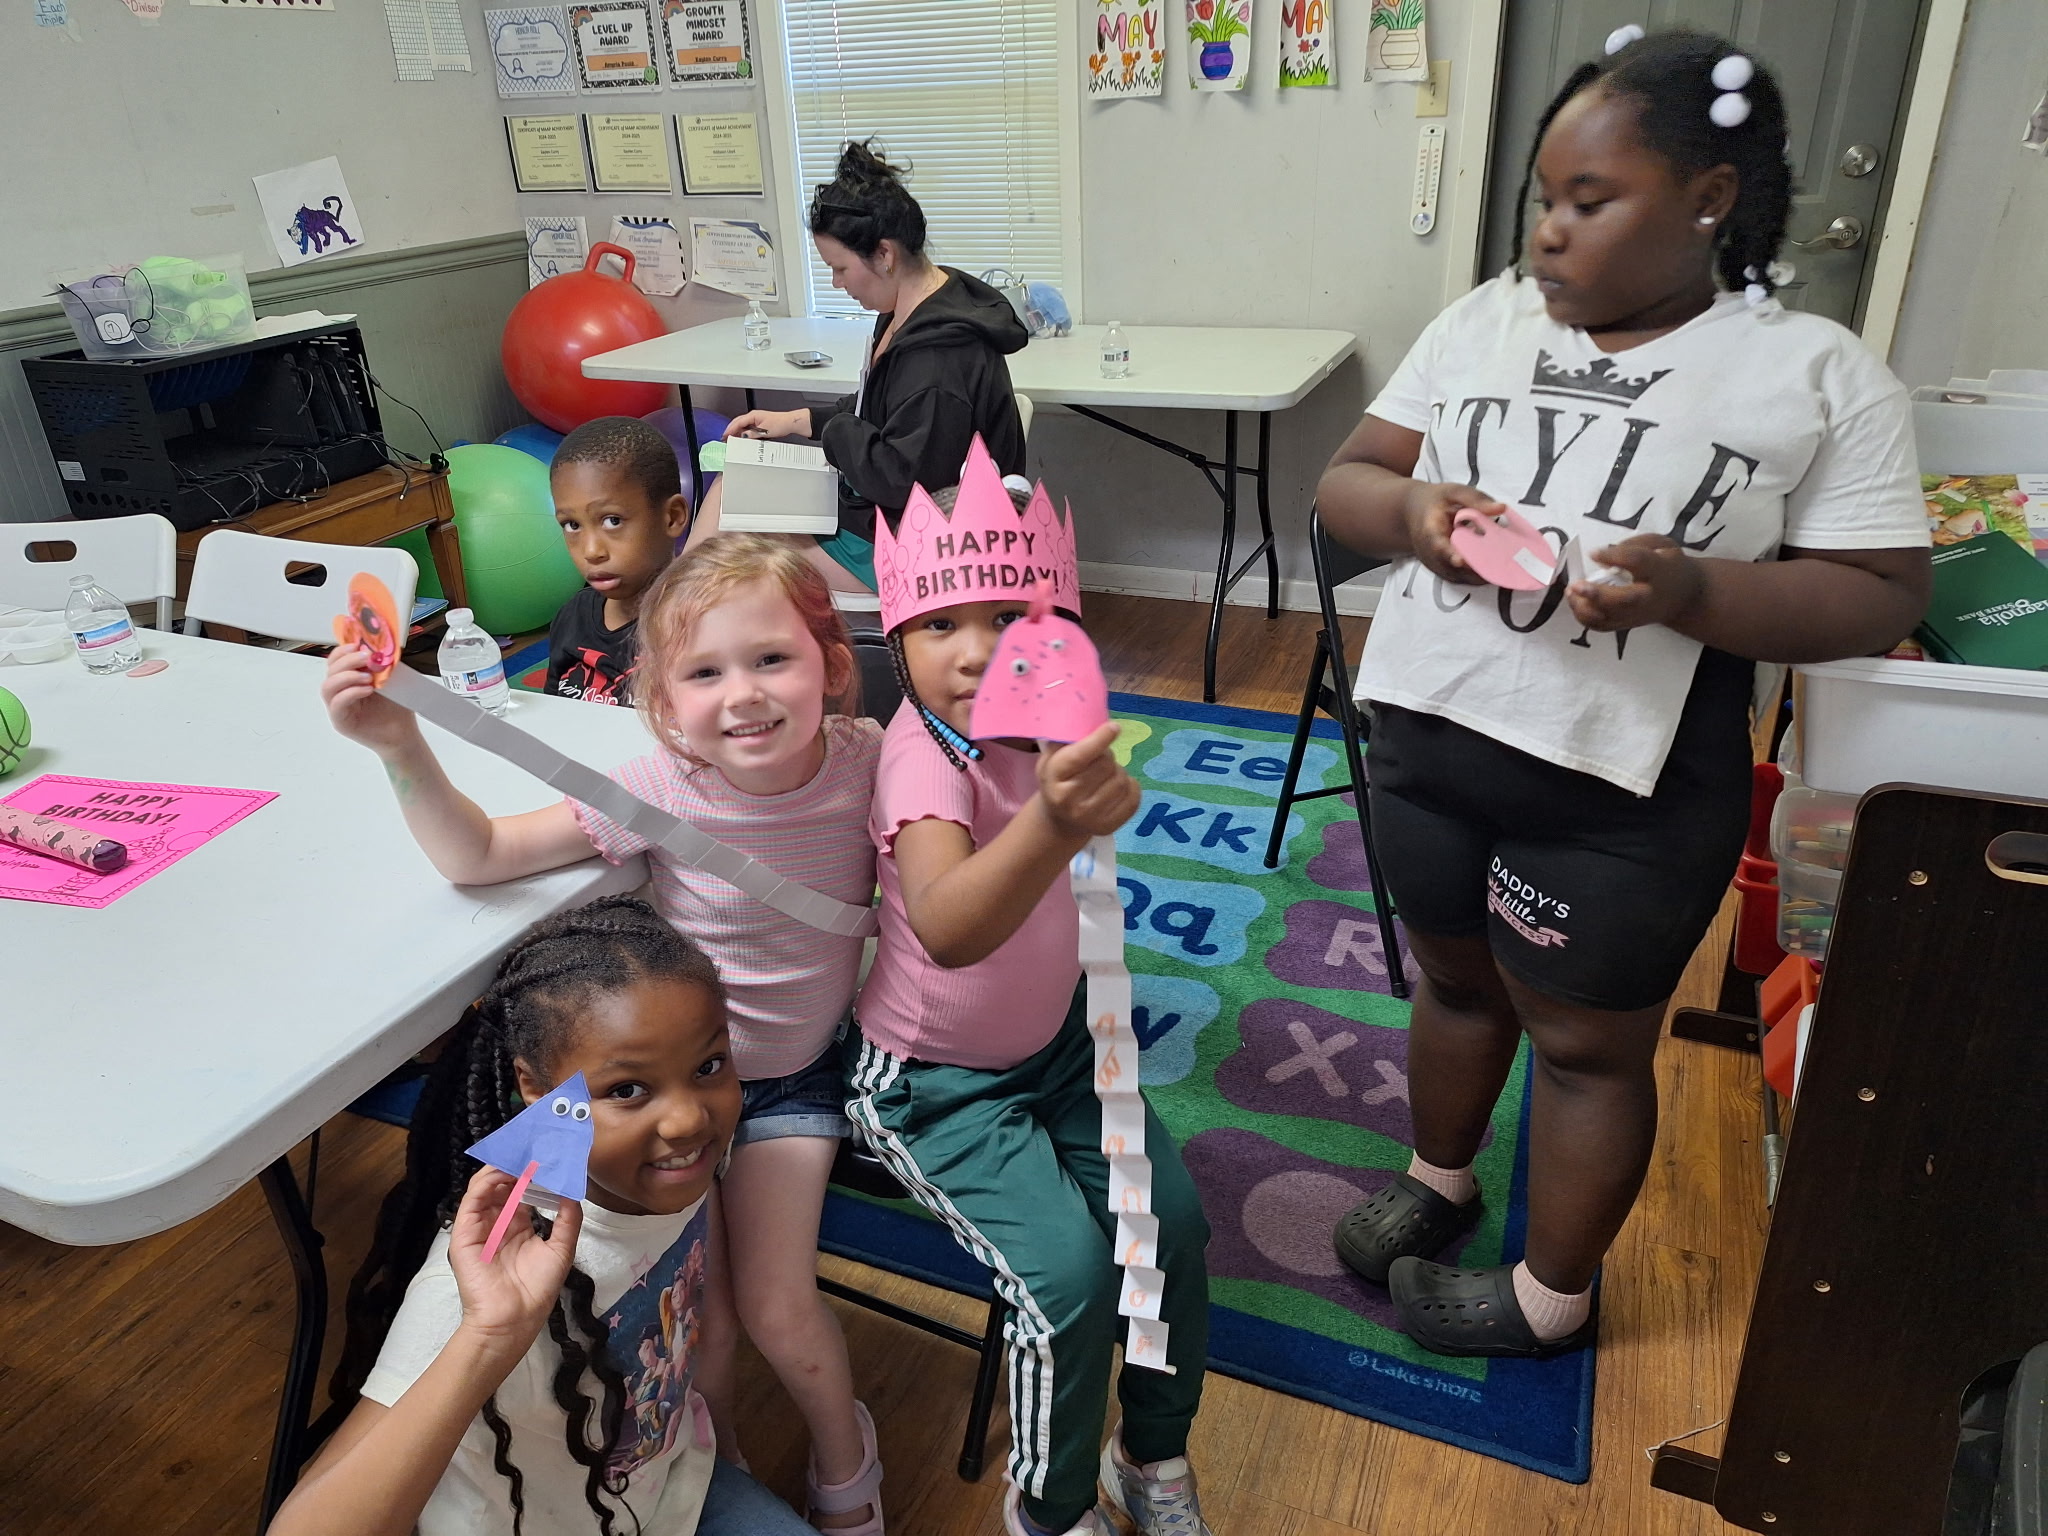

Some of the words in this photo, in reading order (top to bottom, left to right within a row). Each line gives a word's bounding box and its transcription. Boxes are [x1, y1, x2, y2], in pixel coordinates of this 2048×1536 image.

[36, 14, 65, 25] Triple
[685, 6, 724, 17] GROWTH
[1282, 0, 1328, 38] MA
[591, 24, 619, 35] LEVEL
[621, 23, 633, 33] UP
[686, 18, 726, 30] MINDSET
[692, 30, 724, 41] AWARD
[1097, 9, 1158, 53] MAY
[600, 36, 630, 46] AWARD
[1432, 398, 1760, 552] TYLE
[936, 530, 1036, 560] HAPPY
[916, 564, 1060, 600] BIRTHDAY!
[1955, 610, 1985, 622] BANK
[1977, 599, 2048, 626] agnolia
[1984, 602, 2015, 614] STATE
[581, 686, 619, 706] Klein
[1185, 740, 1288, 781] Ee
[86, 792, 182, 809] HAPPY
[40, 804, 182, 826] BIRTHDAY!
[1135, 803, 1257, 853] Kk
[1491, 856, 1571, 919] DADDY'S
[1502, 892, 1537, 924] little
[1371, 1357, 1483, 1404] Lakeshore
